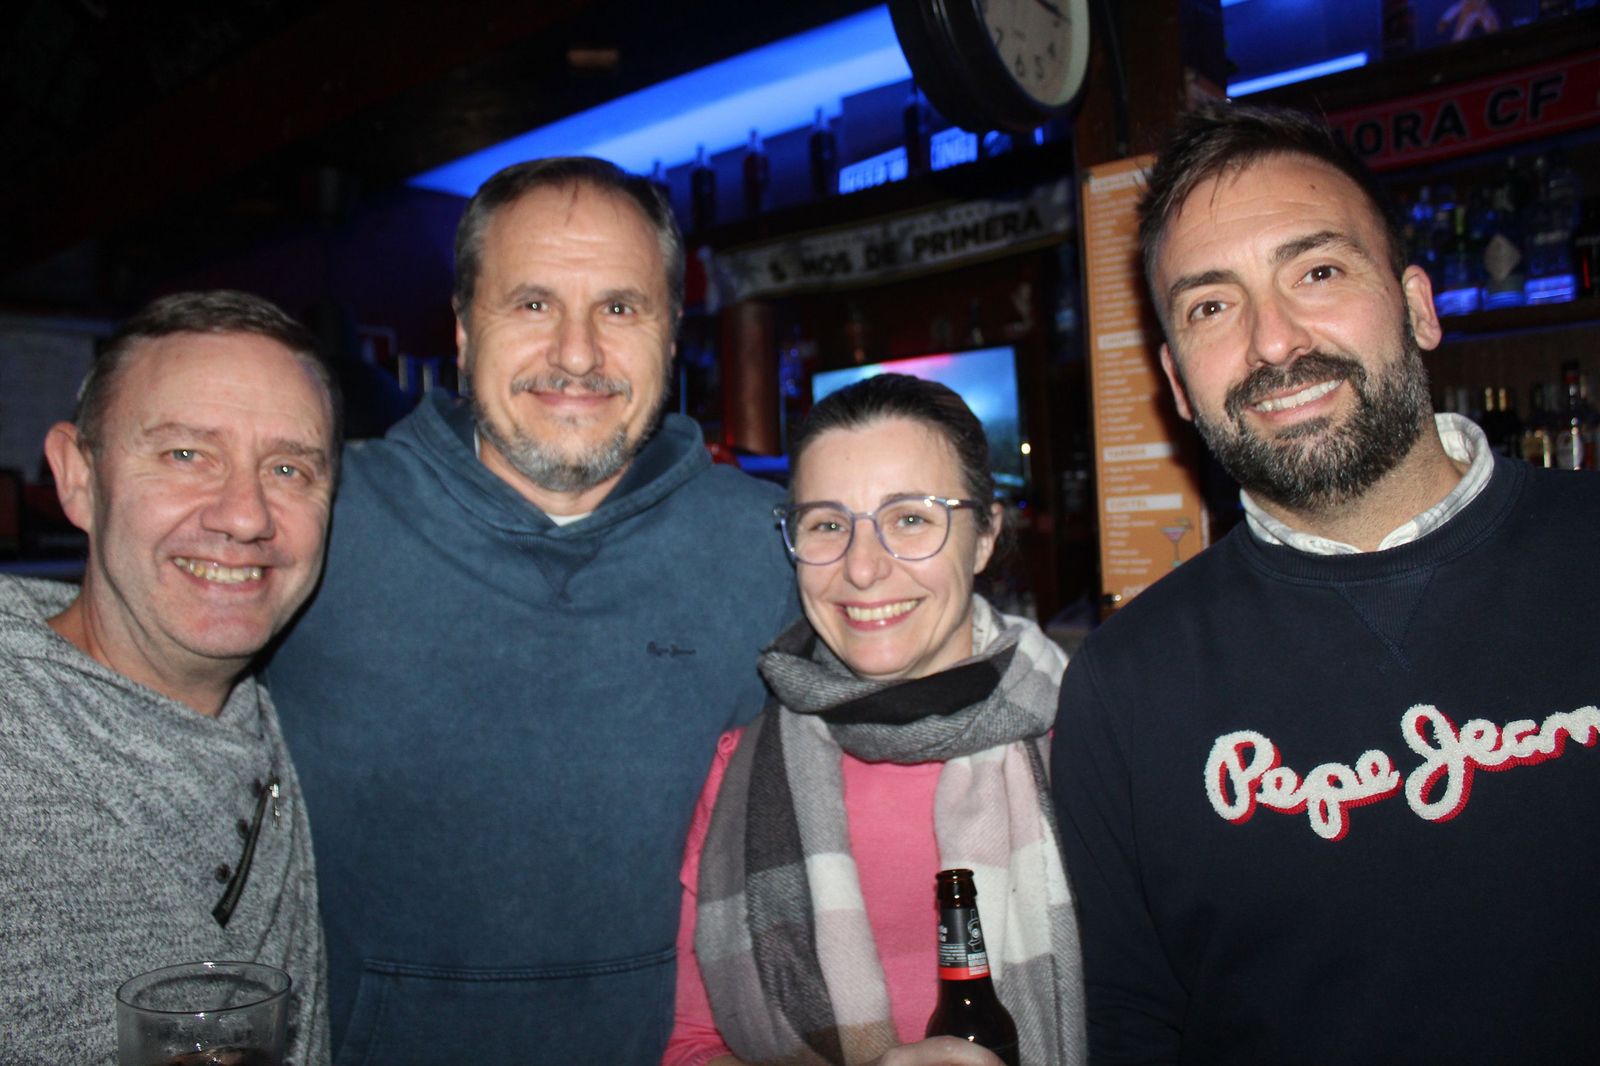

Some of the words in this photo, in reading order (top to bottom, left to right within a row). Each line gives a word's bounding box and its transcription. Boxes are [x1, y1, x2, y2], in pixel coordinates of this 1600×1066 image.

[1337, 101, 1468, 157] ORA
[1488, 75, 1563, 127] CF
[769, 251, 854, 284] SMOS
[1204, 729, 1402, 840] Pepe
[1401, 703, 1600, 823] Jean
